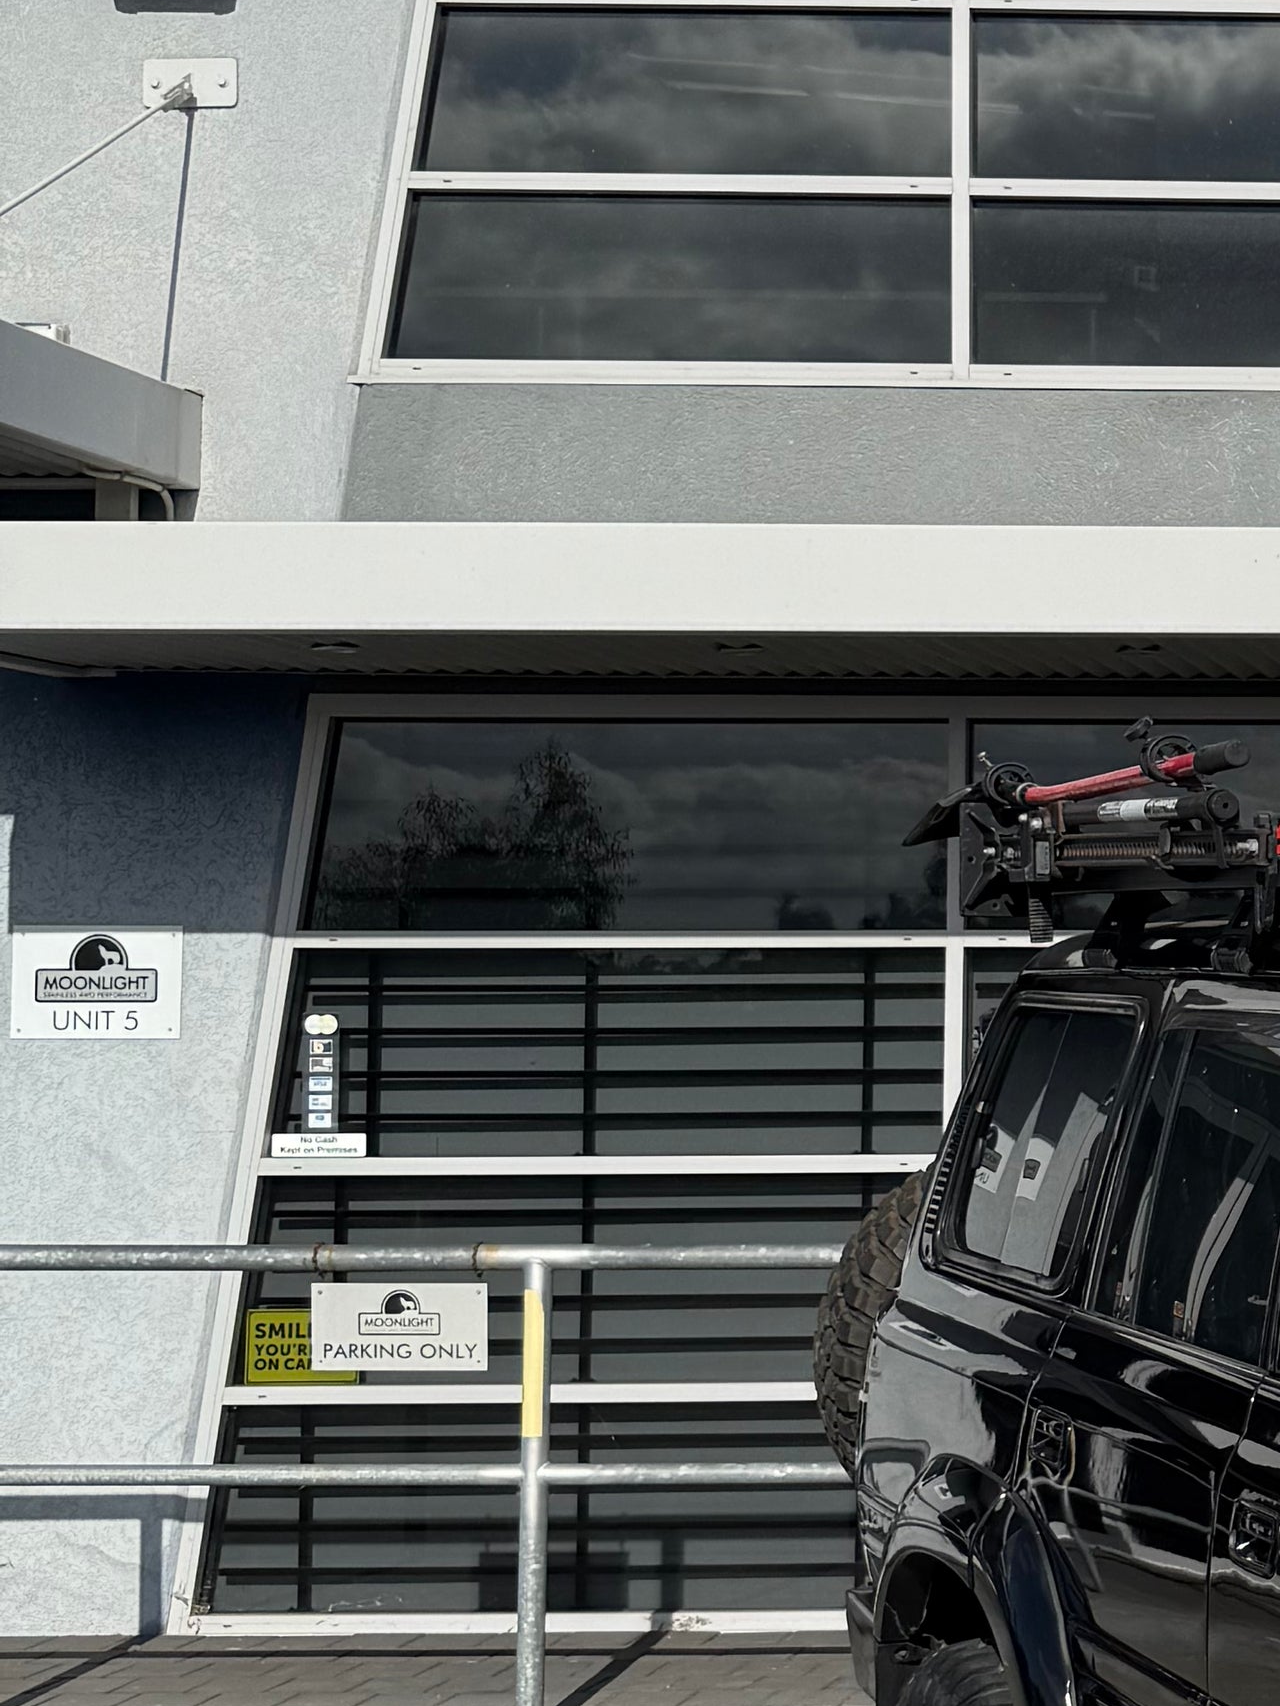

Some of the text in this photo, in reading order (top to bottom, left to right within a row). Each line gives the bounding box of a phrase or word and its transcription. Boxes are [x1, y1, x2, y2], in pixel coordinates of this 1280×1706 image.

[43, 975, 149, 990] MOONLIGHT
[53, 1010, 139, 1031] UNIT 5
[315, 1136, 338, 1144] Cash
[280, 1146, 301, 1154] Kept
[364, 1318, 435, 1328] MOONLIGHT
[255, 1343, 312, 1357] YOU'R
[323, 1343, 478, 1359] PARKING ONLY
[254, 1357, 279, 1370] ON
